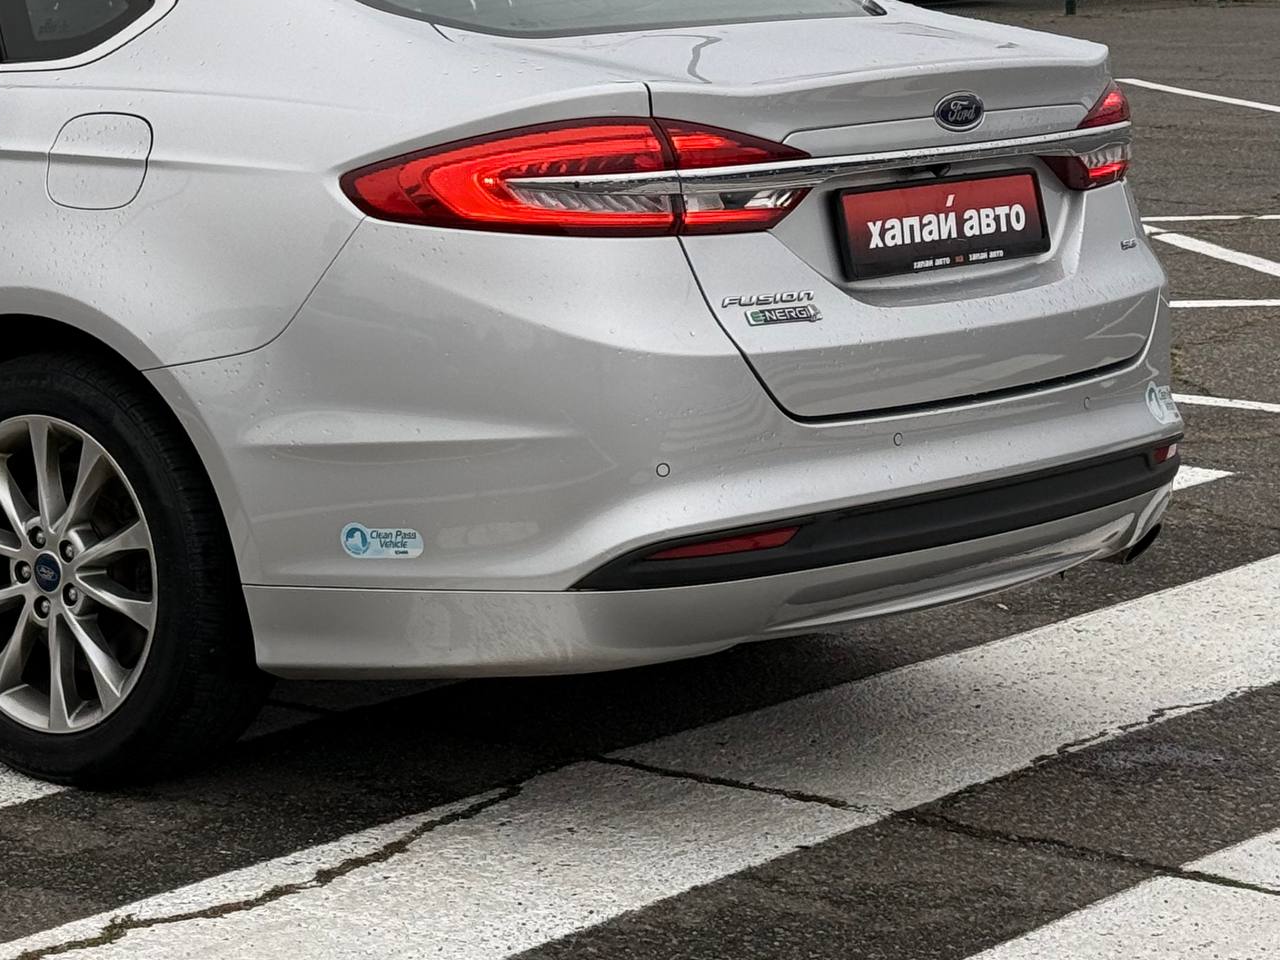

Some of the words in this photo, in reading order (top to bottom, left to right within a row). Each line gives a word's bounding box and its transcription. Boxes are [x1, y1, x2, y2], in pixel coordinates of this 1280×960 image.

[948, 100, 976, 122] Ford
[867, 194, 958, 249] хапай
[963, 203, 1026, 238] авто
[721, 290, 815, 308] FUSION
[370, 530, 393, 539] Clean
[395, 530, 417, 540] Pass
[380, 539, 408, 549] Vehicle
